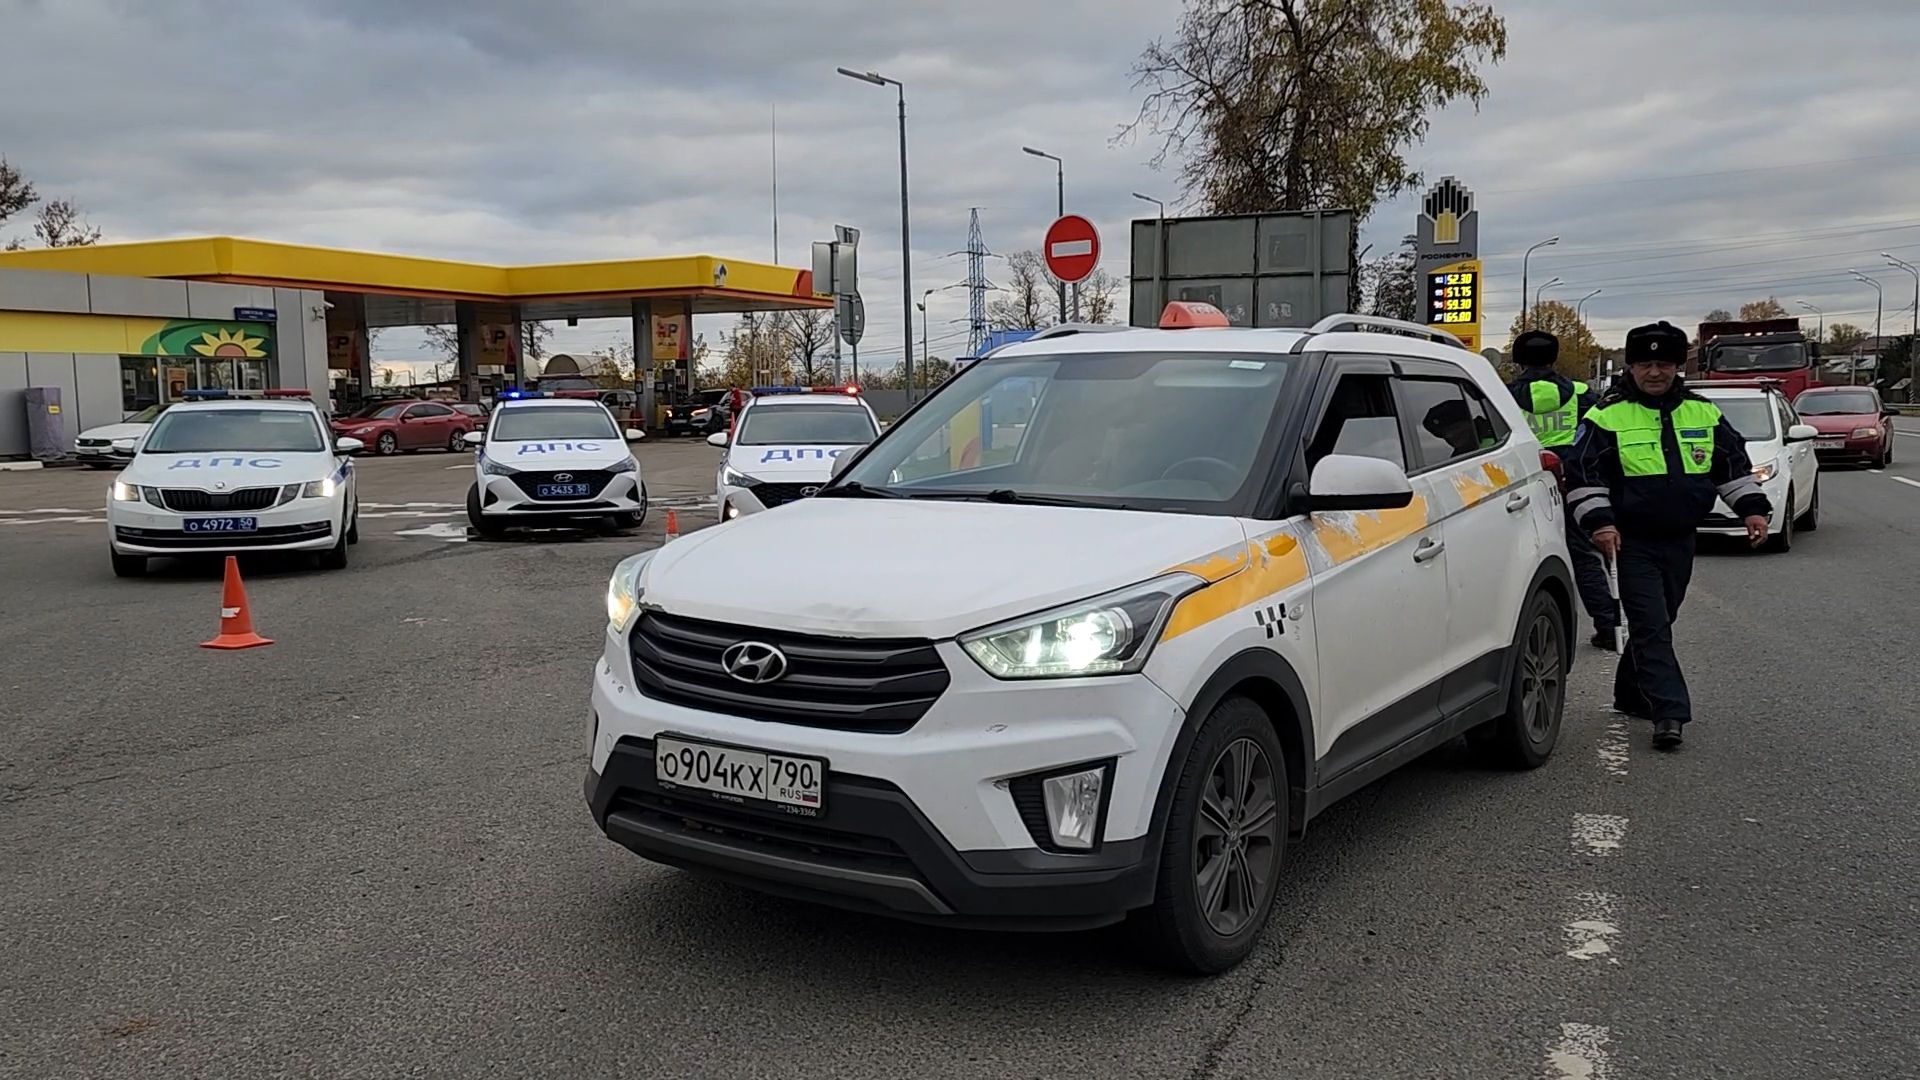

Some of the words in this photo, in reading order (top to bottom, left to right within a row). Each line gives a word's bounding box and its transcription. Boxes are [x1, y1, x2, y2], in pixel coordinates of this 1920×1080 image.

[1421, 252, 1472, 260] РОСНЕФТЬ
[1447, 273, 1473, 285] 52.30
[1447, 298, 1473, 310] 59.30
[518, 442, 600, 455] ДПС
[168, 458, 282, 470] ДПС
[551, 485, 573, 494] 5435
[202, 519, 233, 530] 4972
[240, 517, 253, 527] 50
[769, 758, 814, 790] 790
[780, 788, 802, 800] RUS
